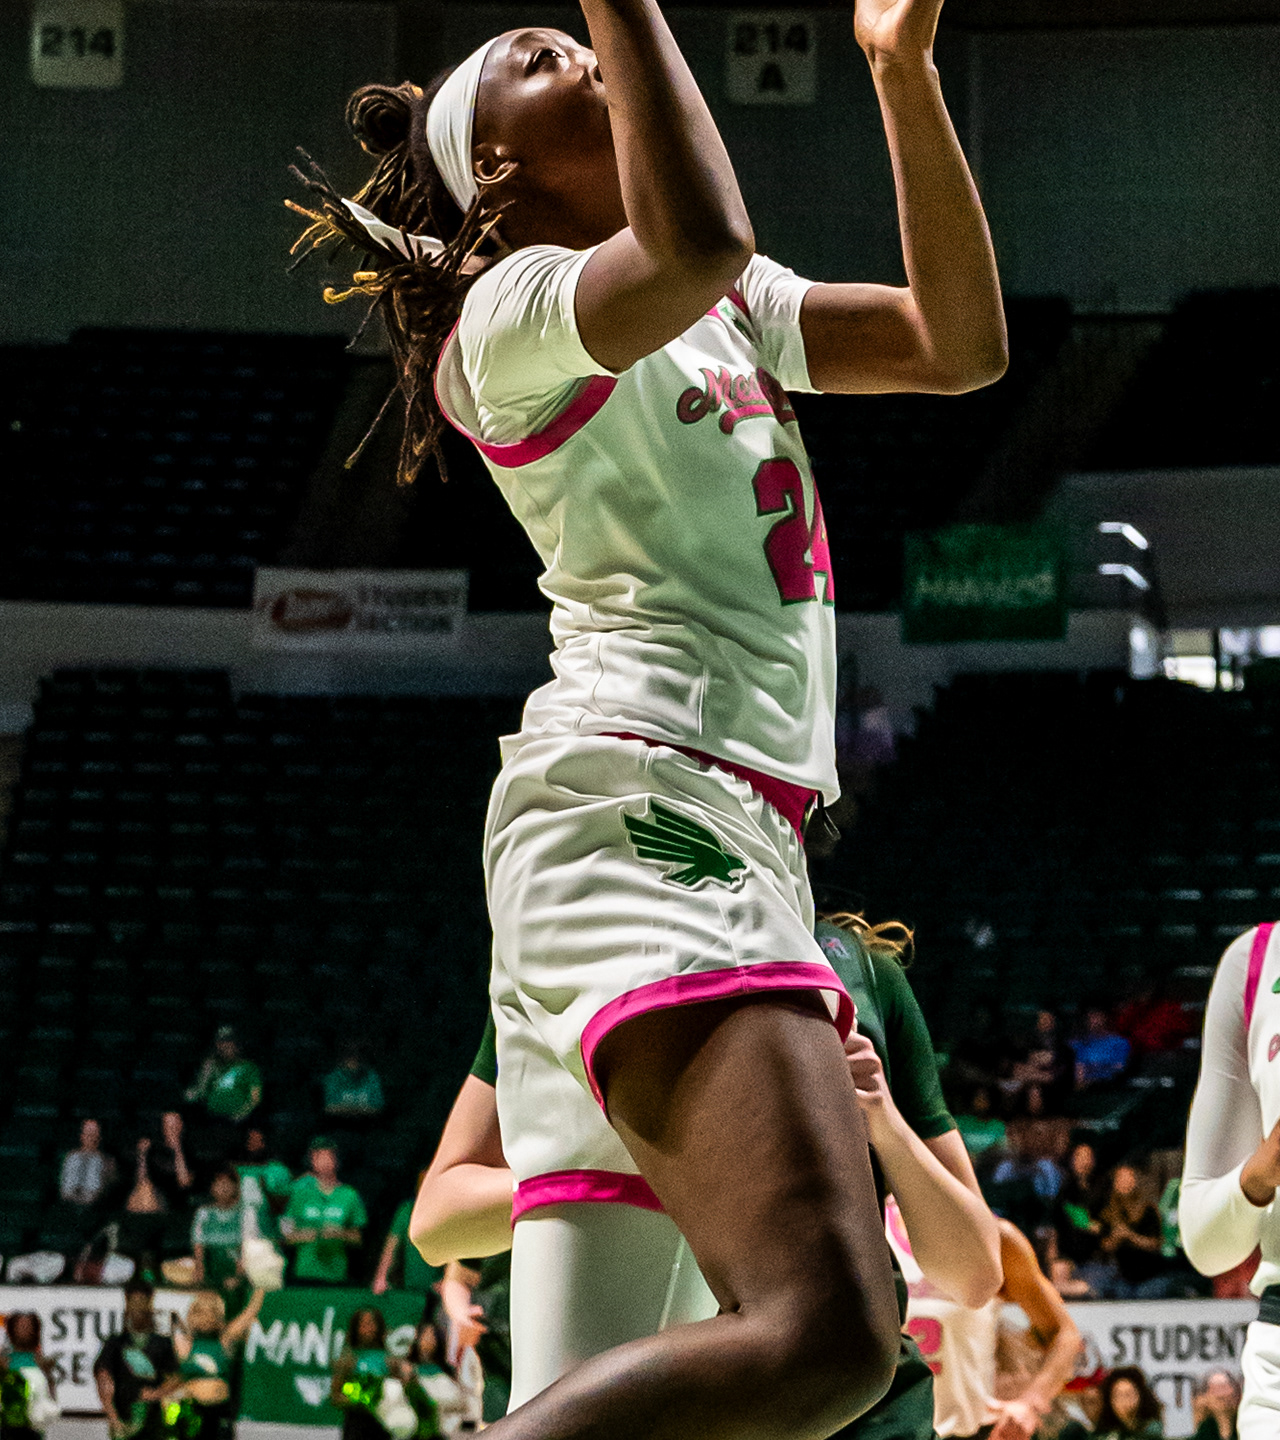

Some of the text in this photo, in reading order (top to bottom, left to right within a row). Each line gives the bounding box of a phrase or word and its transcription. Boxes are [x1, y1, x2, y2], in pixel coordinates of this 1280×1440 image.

[38, 23, 116, 60] 214
[732, 22, 811, 55] 214
[245, 1304, 418, 1369] MANIC
